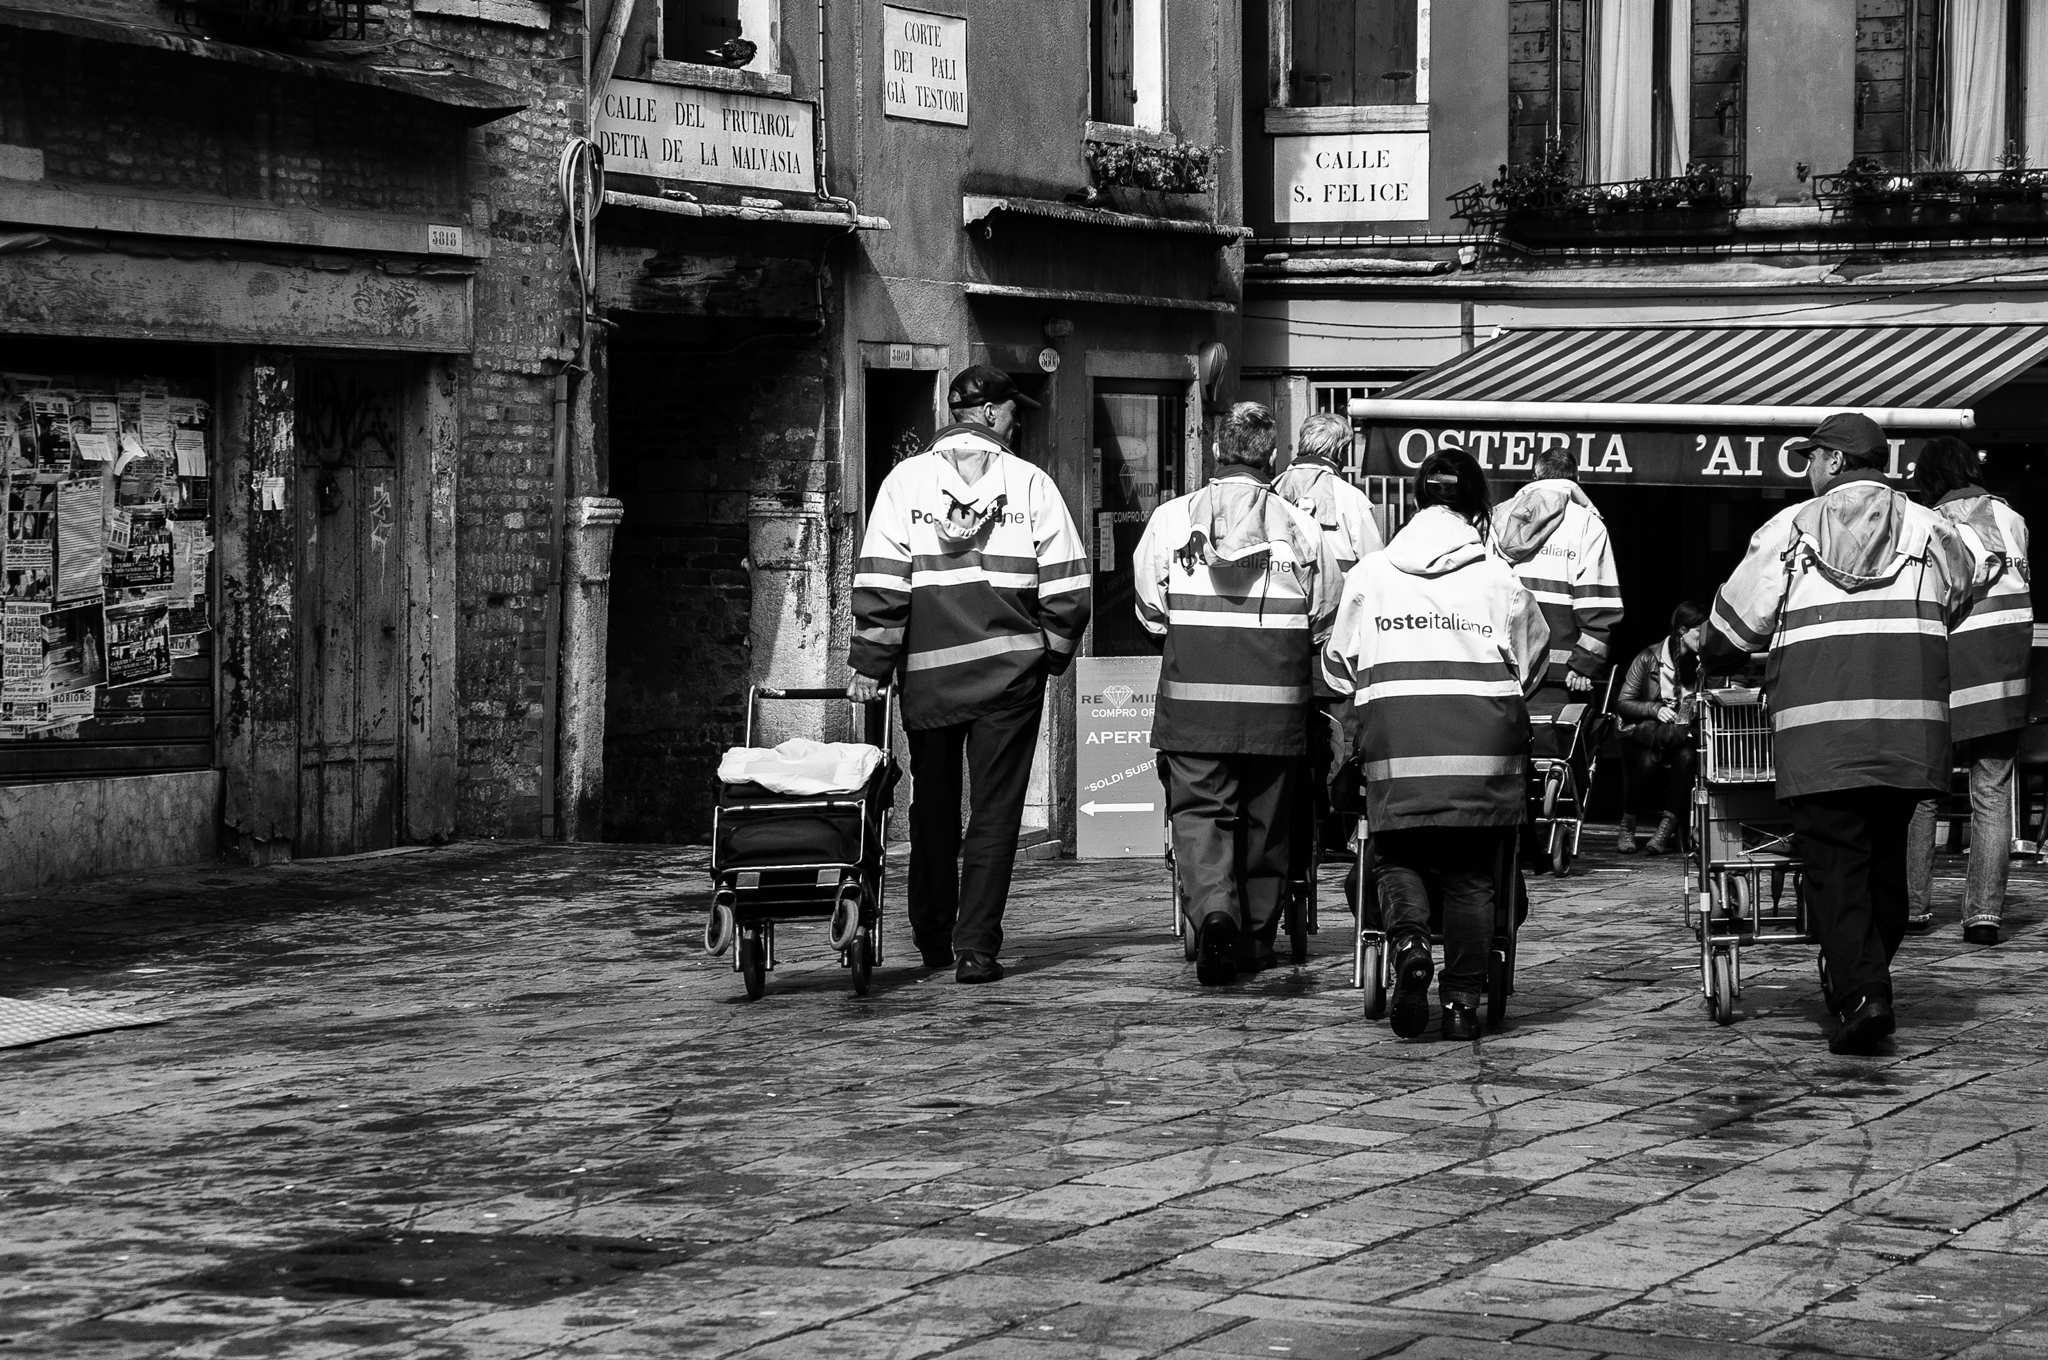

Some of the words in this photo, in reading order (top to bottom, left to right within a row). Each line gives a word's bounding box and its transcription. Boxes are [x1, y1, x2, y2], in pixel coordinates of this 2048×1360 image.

[904, 21, 942, 48] CORTE
[893, 48, 914, 75] DEI
[931, 55, 957, 81] PALI
[886, 77, 908, 105] GIÀ
[915, 85, 965, 114] TESTORI
[605, 93, 657, 124] CALLE
[675, 102, 705, 129] DEL
[722, 108, 795, 138] FRUTAROL
[600, 131, 649, 161] DETTA
[662, 137, 683, 164] DE
[700, 142, 719, 168] LA
[731, 145, 802, 175] MALVASIA
[1315, 149, 1391, 170] CALLE
[1293, 184, 1313, 203] S.
[1323, 182, 1409, 203] FELICE
[432, 230, 457, 247] 3818
[1113, 510, 1140, 523] COMPRO
[1081, 694, 1104, 705] RE
[1131, 693, 1157, 704] MI
[1091, 708, 1138, 718] COMPRO
[1141, 708, 1156, 718] OR
[1085, 730, 1152, 745] APERT
[1124, 758, 1158, 778] SUBIT
